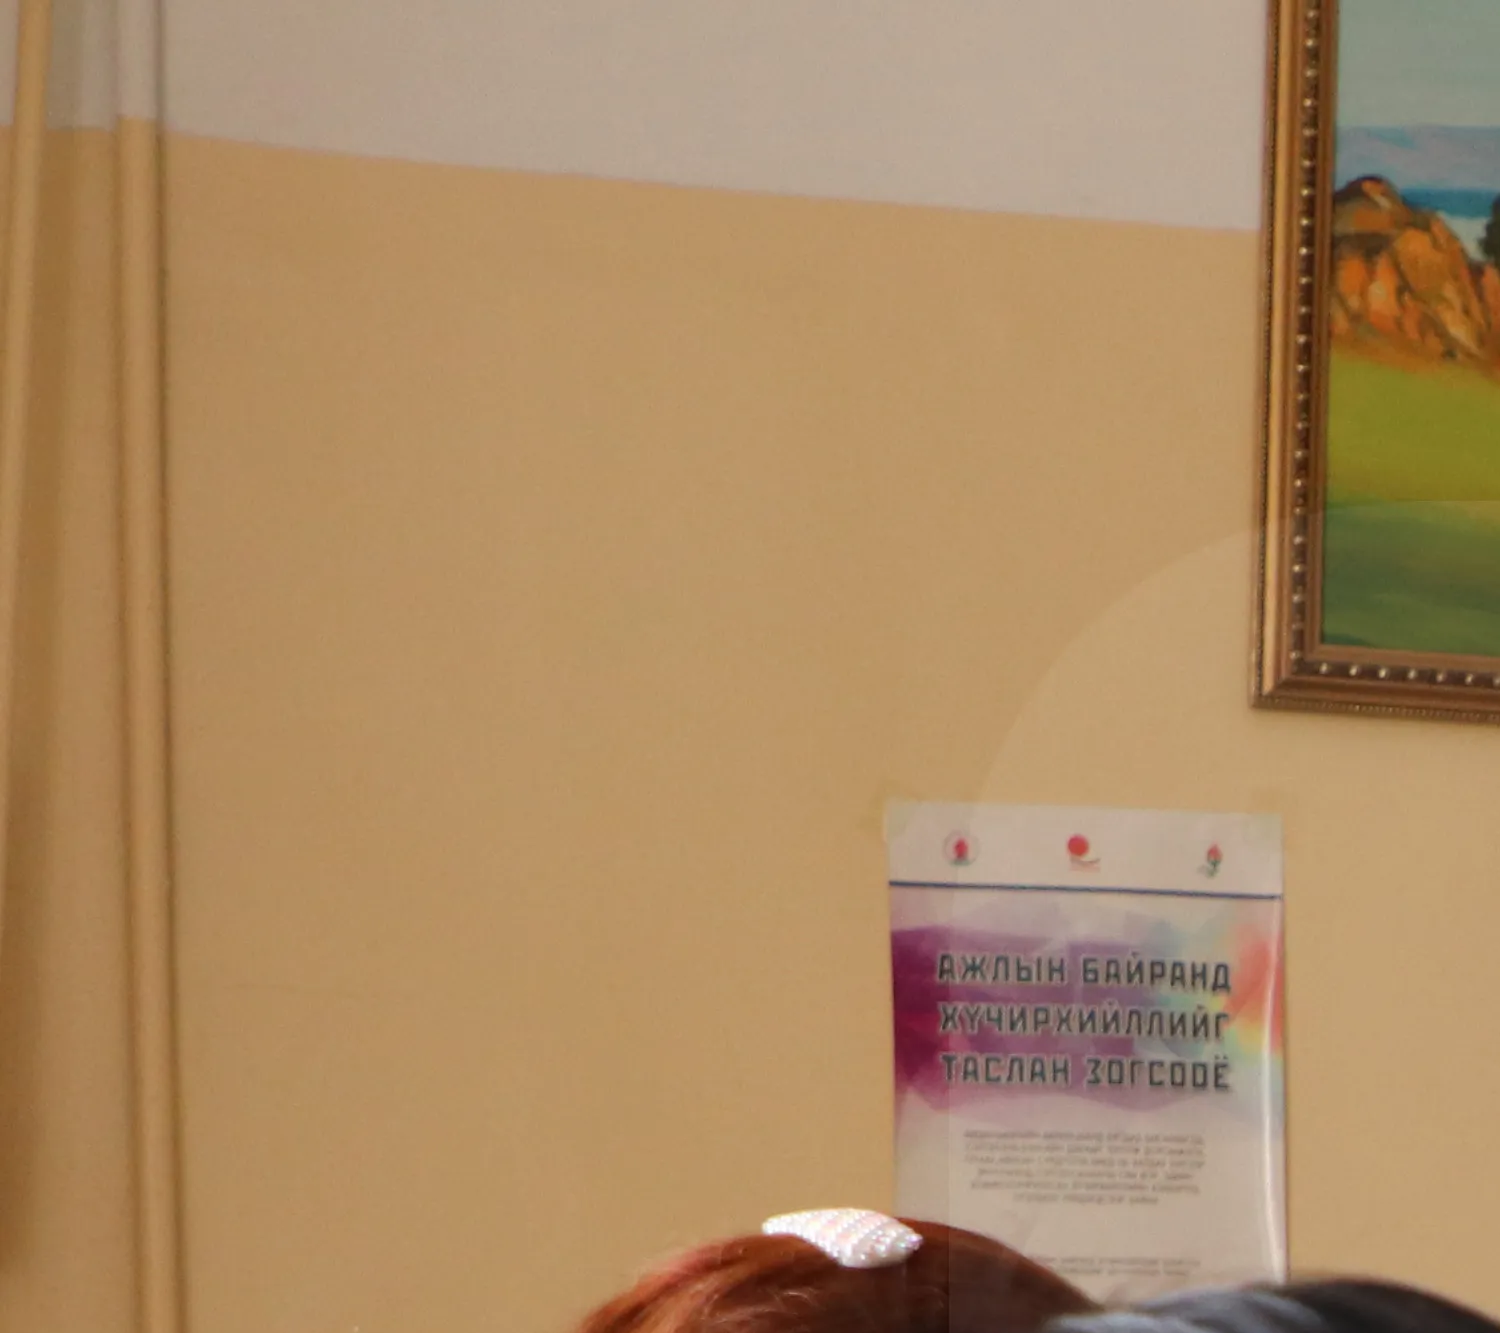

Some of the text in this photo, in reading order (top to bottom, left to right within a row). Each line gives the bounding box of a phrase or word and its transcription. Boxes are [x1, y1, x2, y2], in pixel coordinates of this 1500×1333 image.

[937, 952, 1232, 993] АЖЛЫН БАЙРАНД
[940, 1000, 1231, 1039] ХҮЧИРХИЙЛЛИЙГ
[940, 1054, 1232, 1090] ТАСЛАН ЗОГСООЁ
